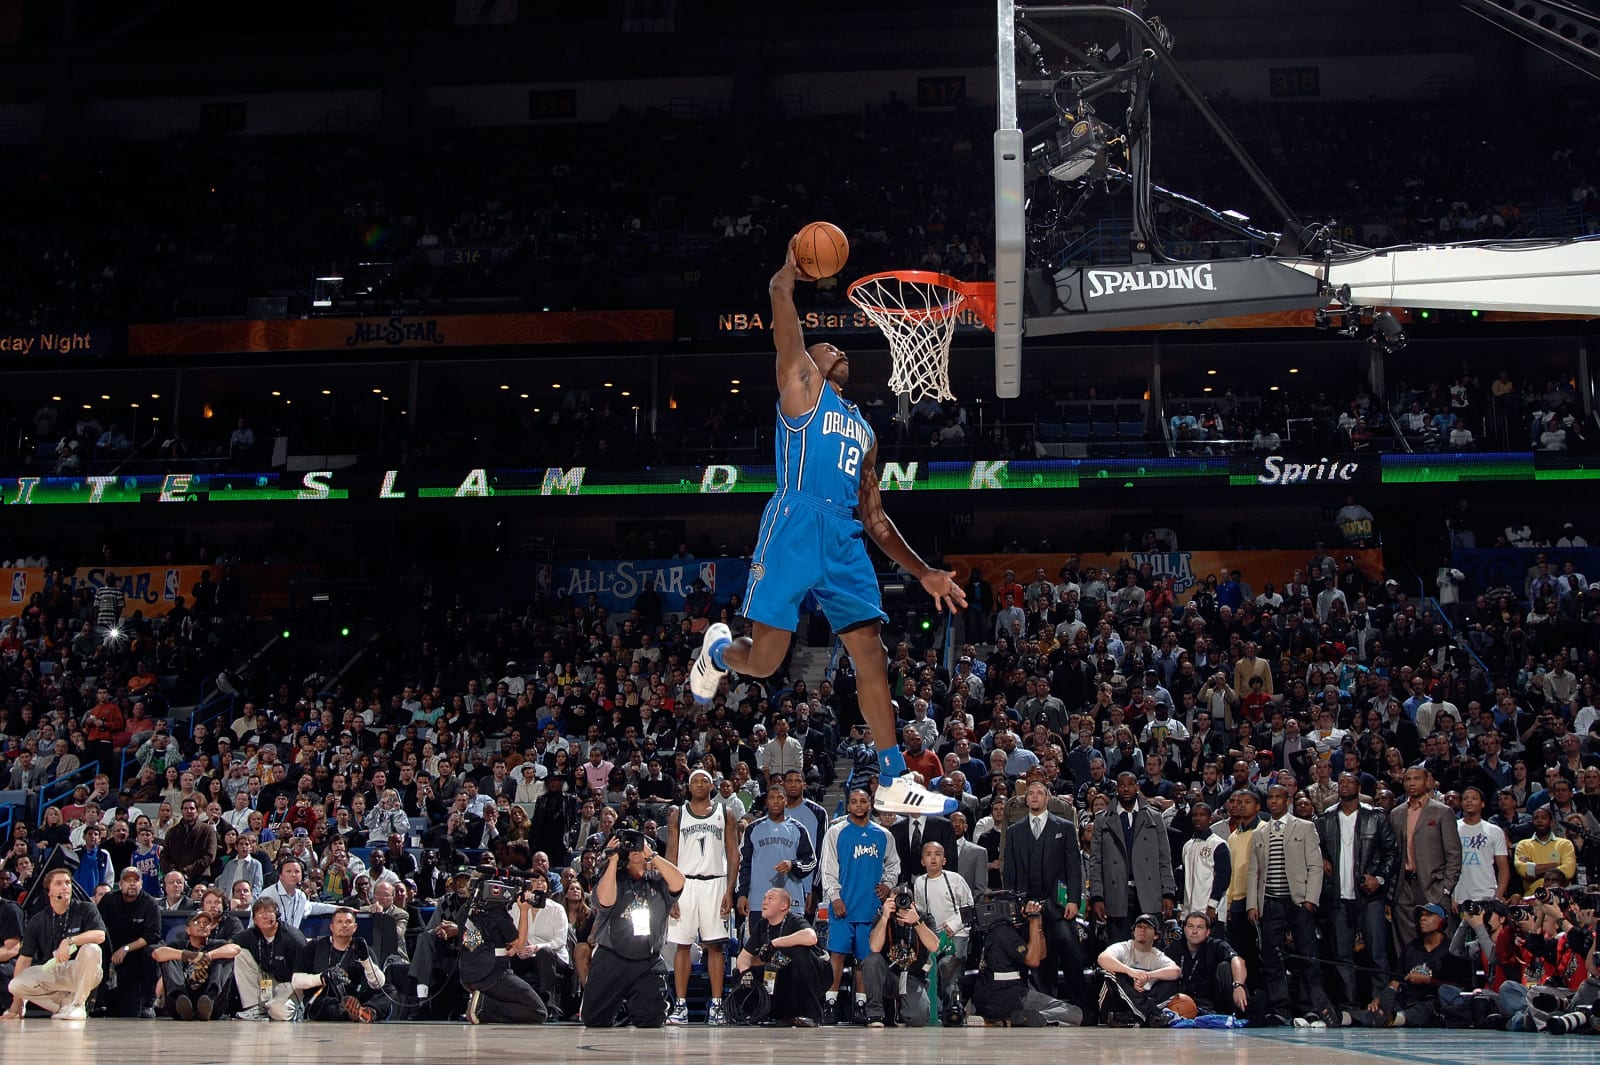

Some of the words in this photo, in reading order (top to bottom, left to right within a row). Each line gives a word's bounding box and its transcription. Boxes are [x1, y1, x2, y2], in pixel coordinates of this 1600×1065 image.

[1087, 263, 1214, 298] SPALDING
[718, 312, 764, 331] NBA
[40, 332, 92, 354] Night
[822, 411, 869, 450] ORLAN
[837, 441, 860, 477] 12
[1132, 552, 1196, 587] NOLA
[695, 835, 706, 857] 1
[758, 836, 794, 849] MEMPHIS
